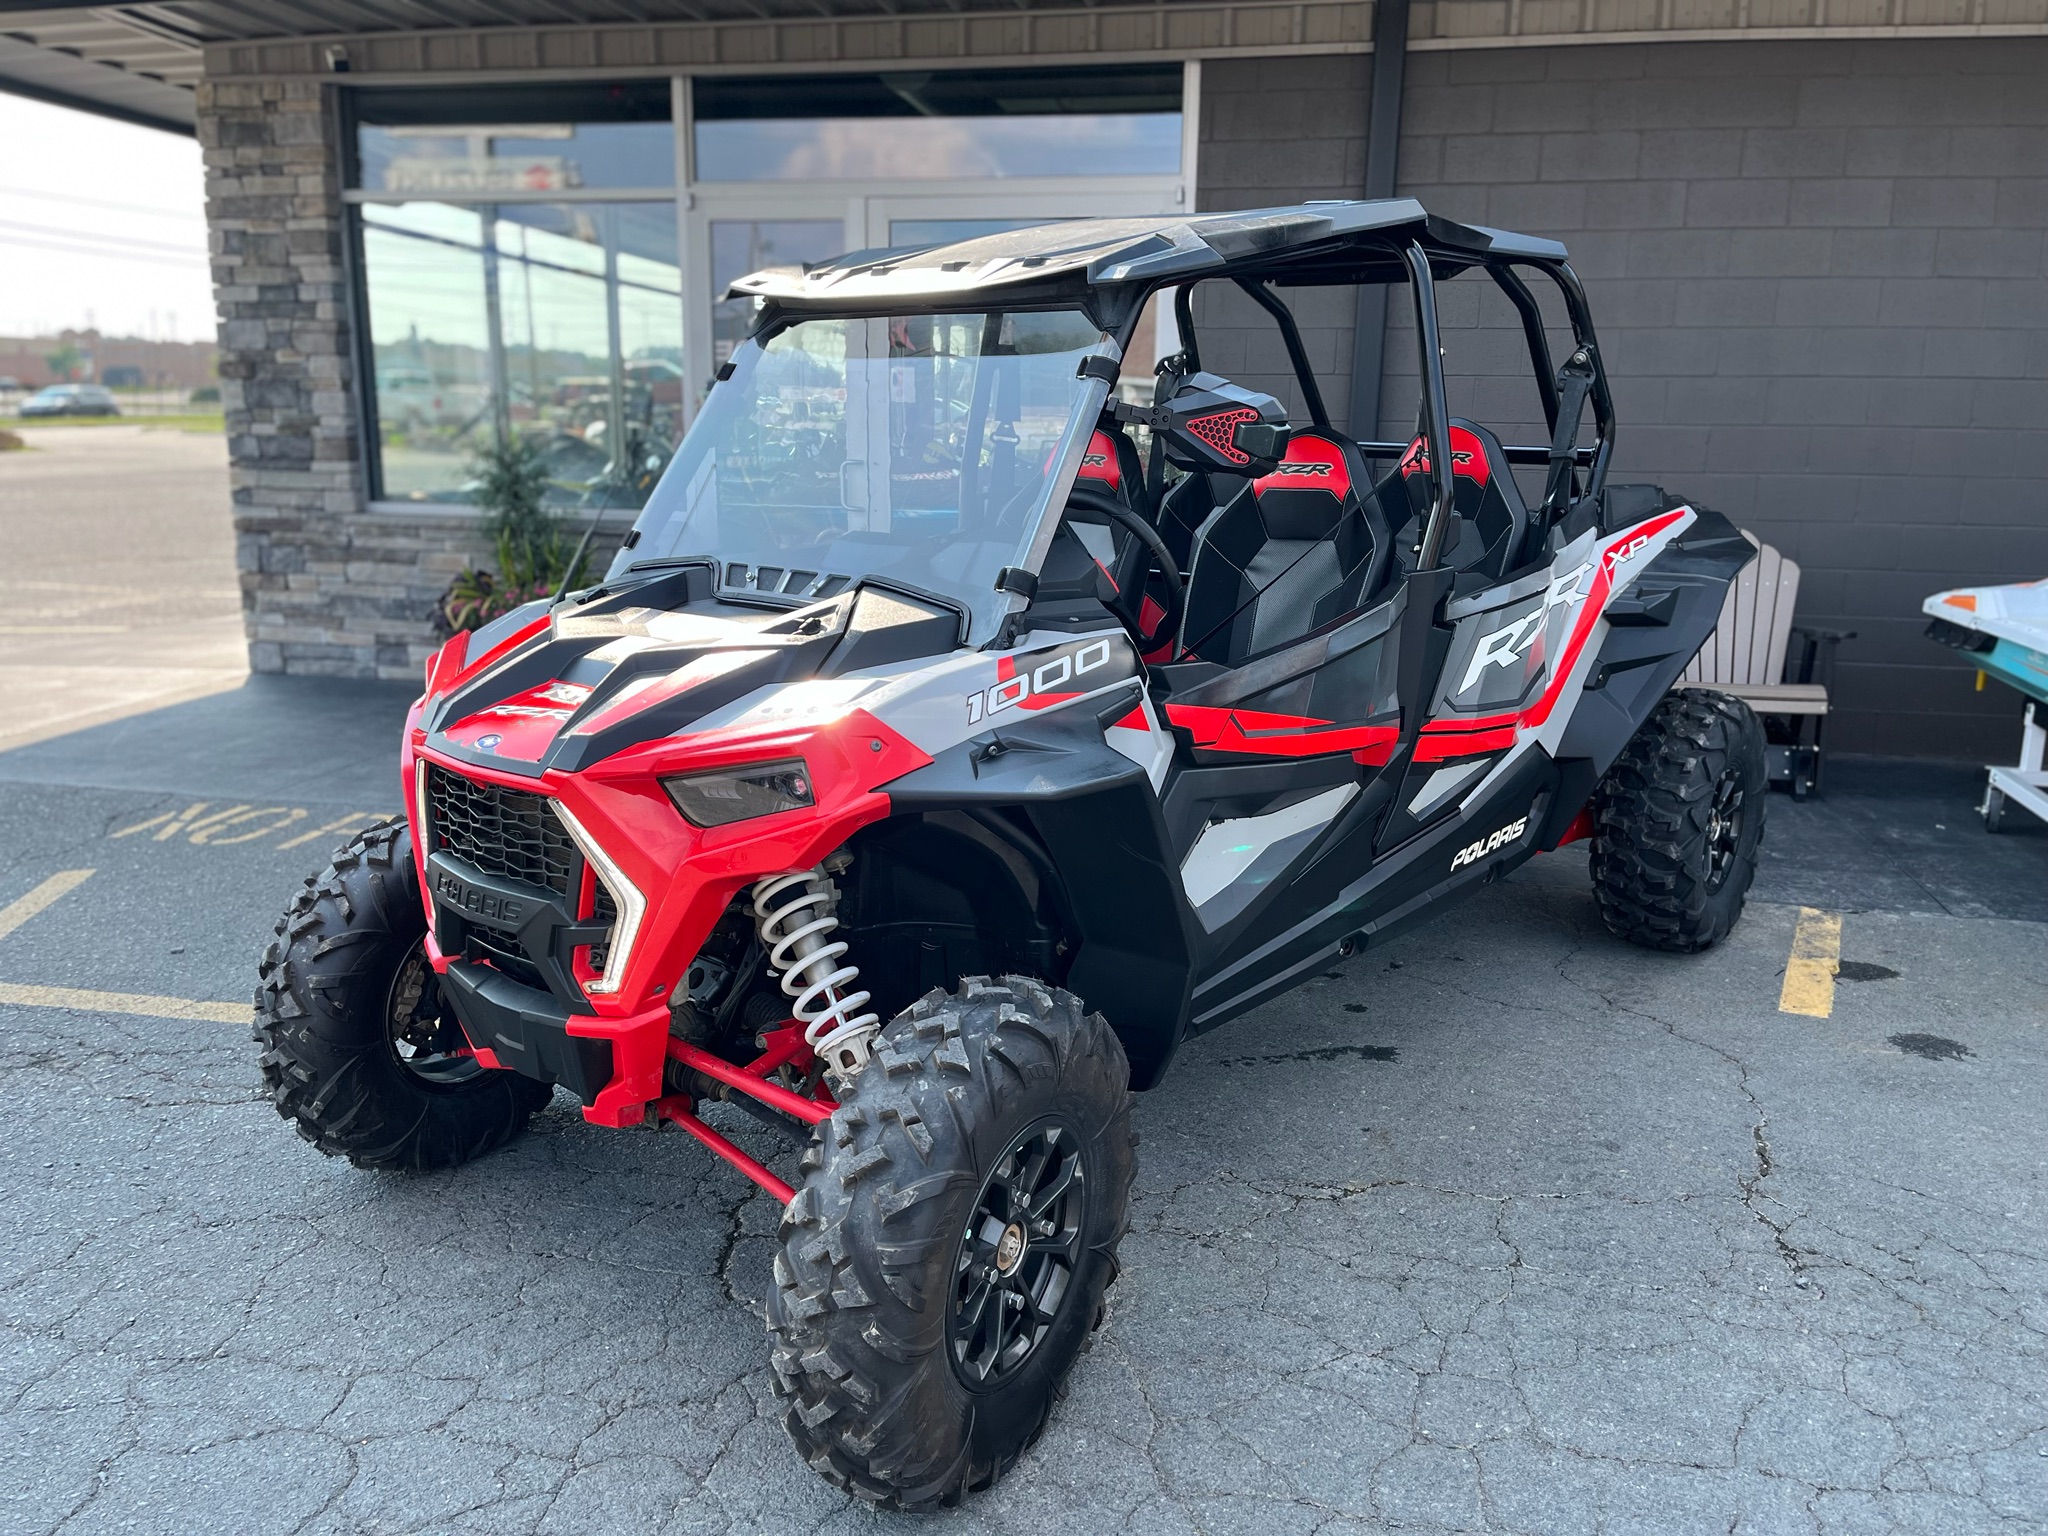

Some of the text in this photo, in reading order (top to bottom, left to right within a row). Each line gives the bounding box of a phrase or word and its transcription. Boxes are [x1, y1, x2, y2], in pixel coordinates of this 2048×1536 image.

[1269, 461, 1334, 477] RZR
[1606, 534, 1650, 571] XP
[1456, 561, 1595, 698] RZR
[966, 638, 1110, 727] 1000
[110, 802, 308, 845] NO
[1450, 815, 1528, 872] POLARIS
[436, 871, 523, 926] POLARIS
